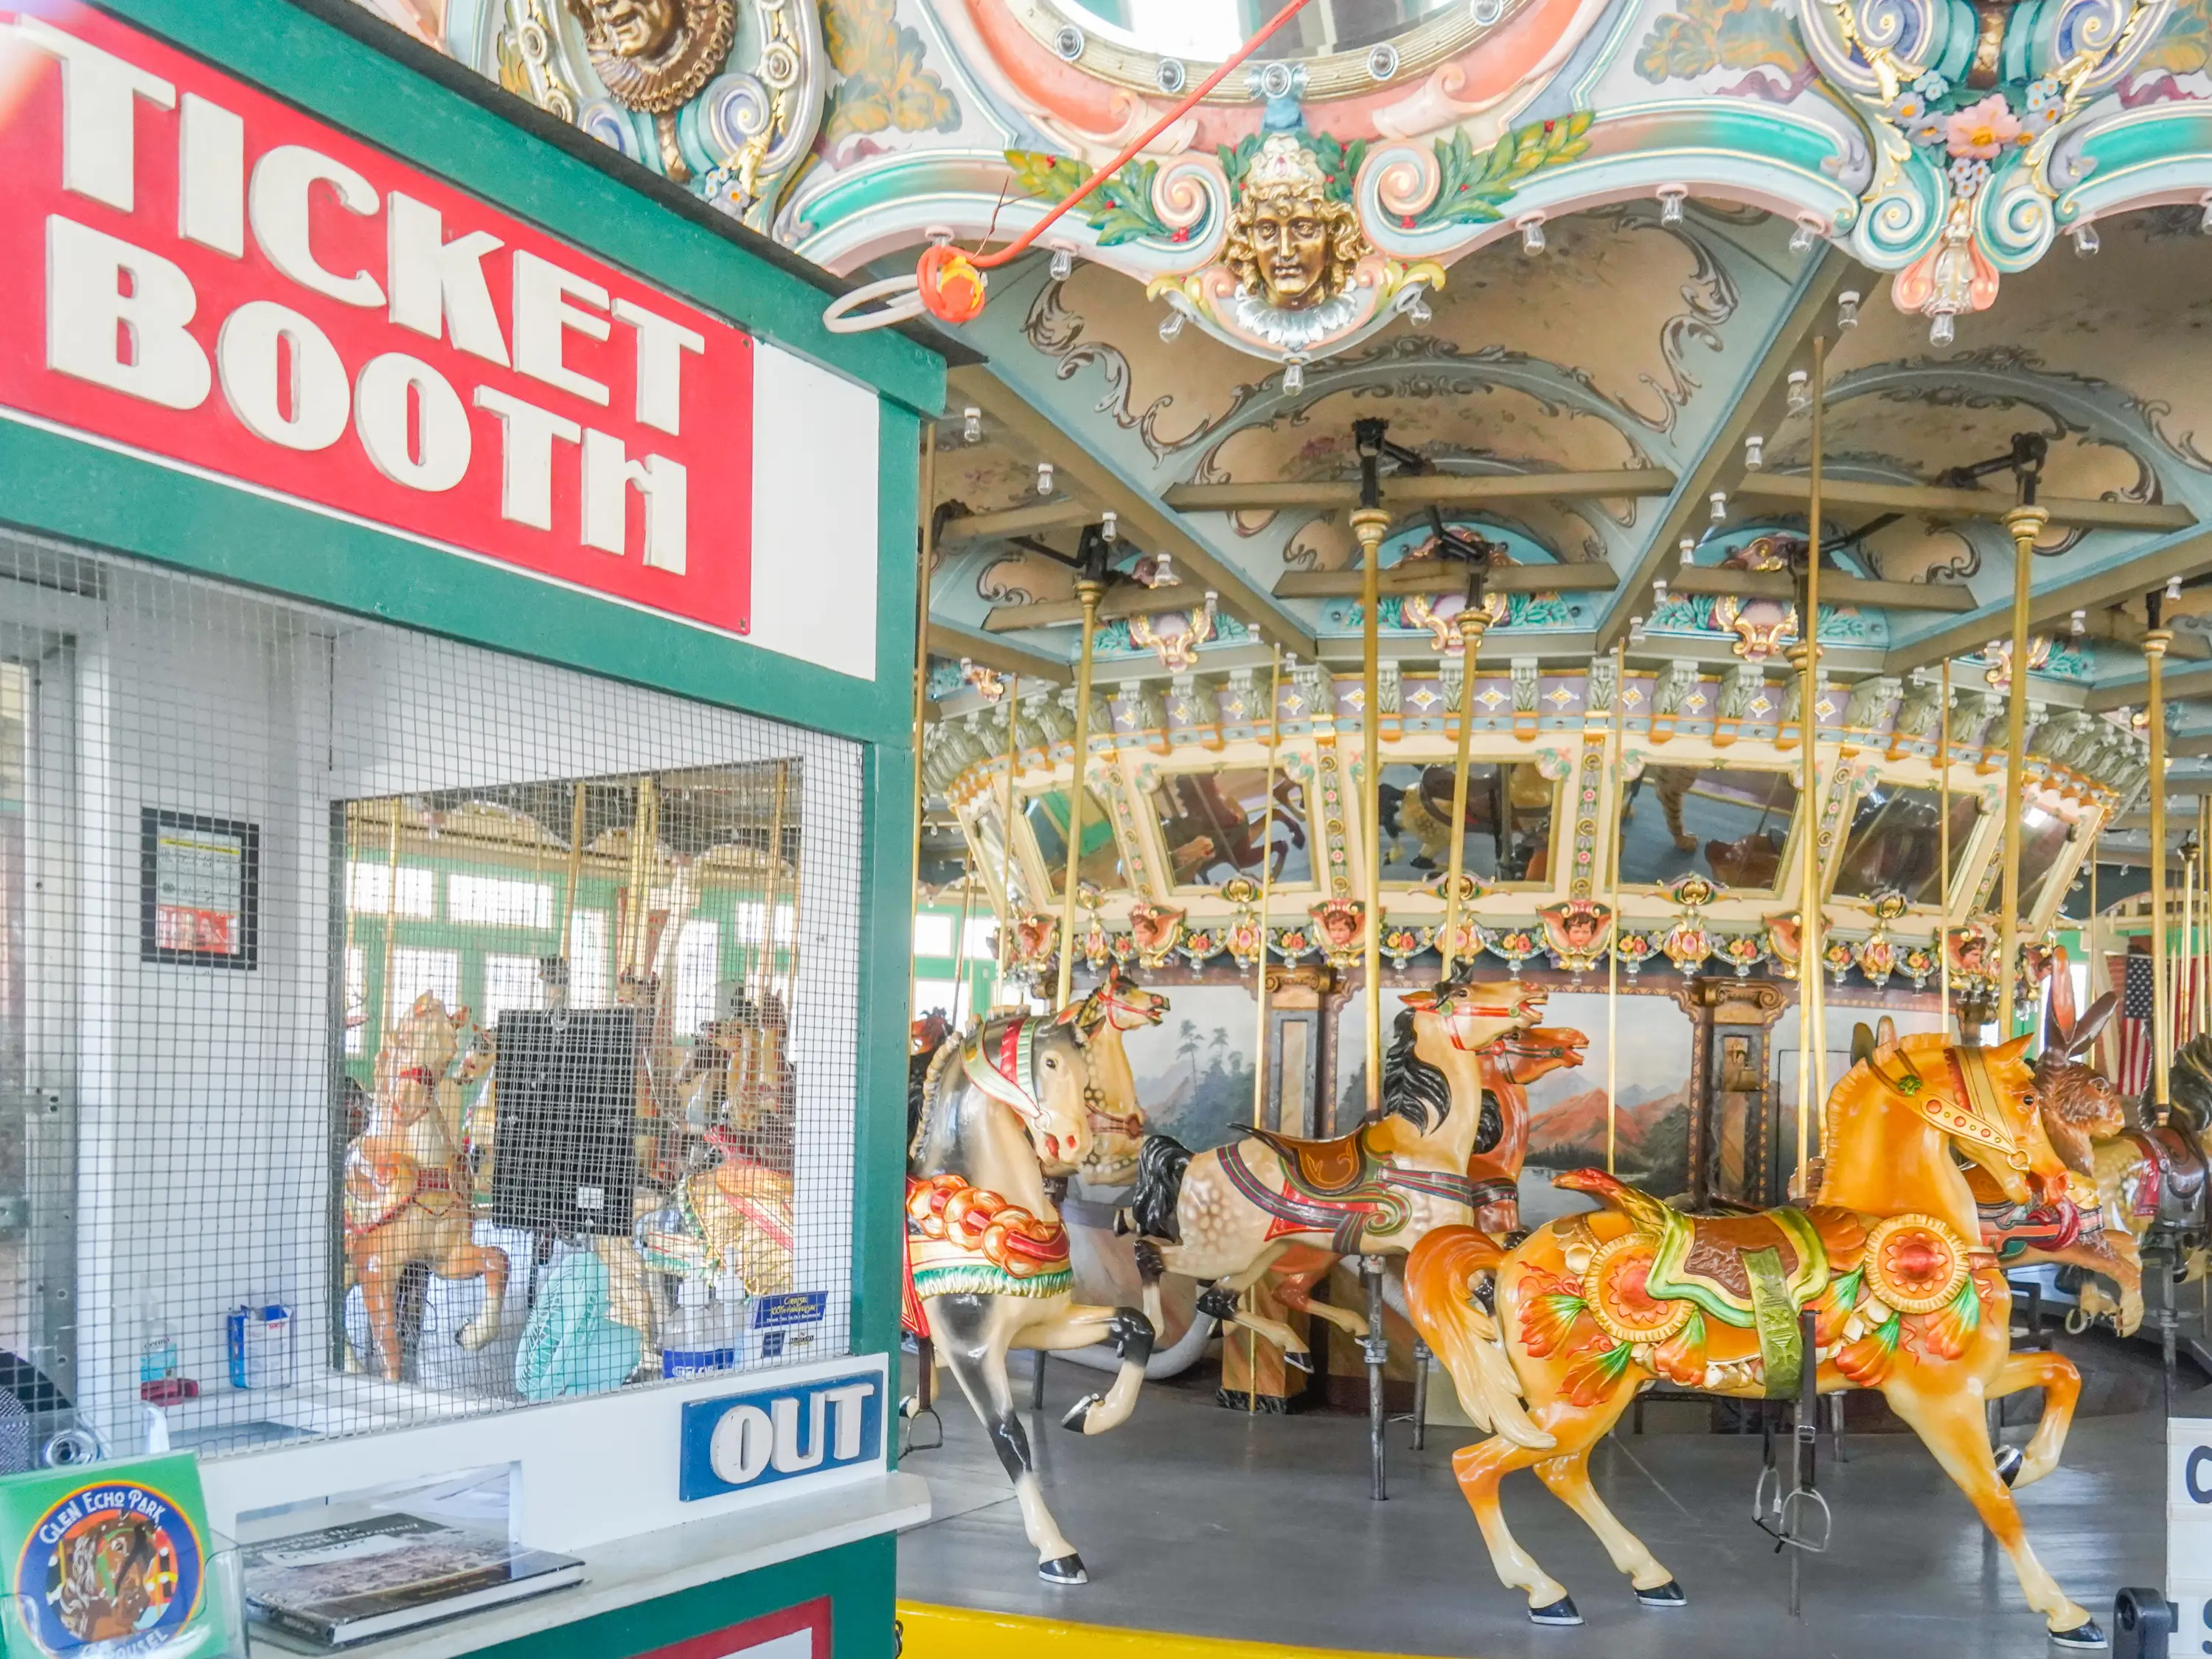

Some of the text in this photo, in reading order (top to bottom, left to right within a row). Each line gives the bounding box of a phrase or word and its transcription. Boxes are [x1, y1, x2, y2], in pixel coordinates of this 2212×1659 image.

[13, 13, 704, 437] TICKET
[46, 214, 687, 577] BOOTH
[39, 1500, 83, 1544] GLEN
[128, 1489, 166, 1526] PARK
[710, 1383, 874, 1484] OUT
